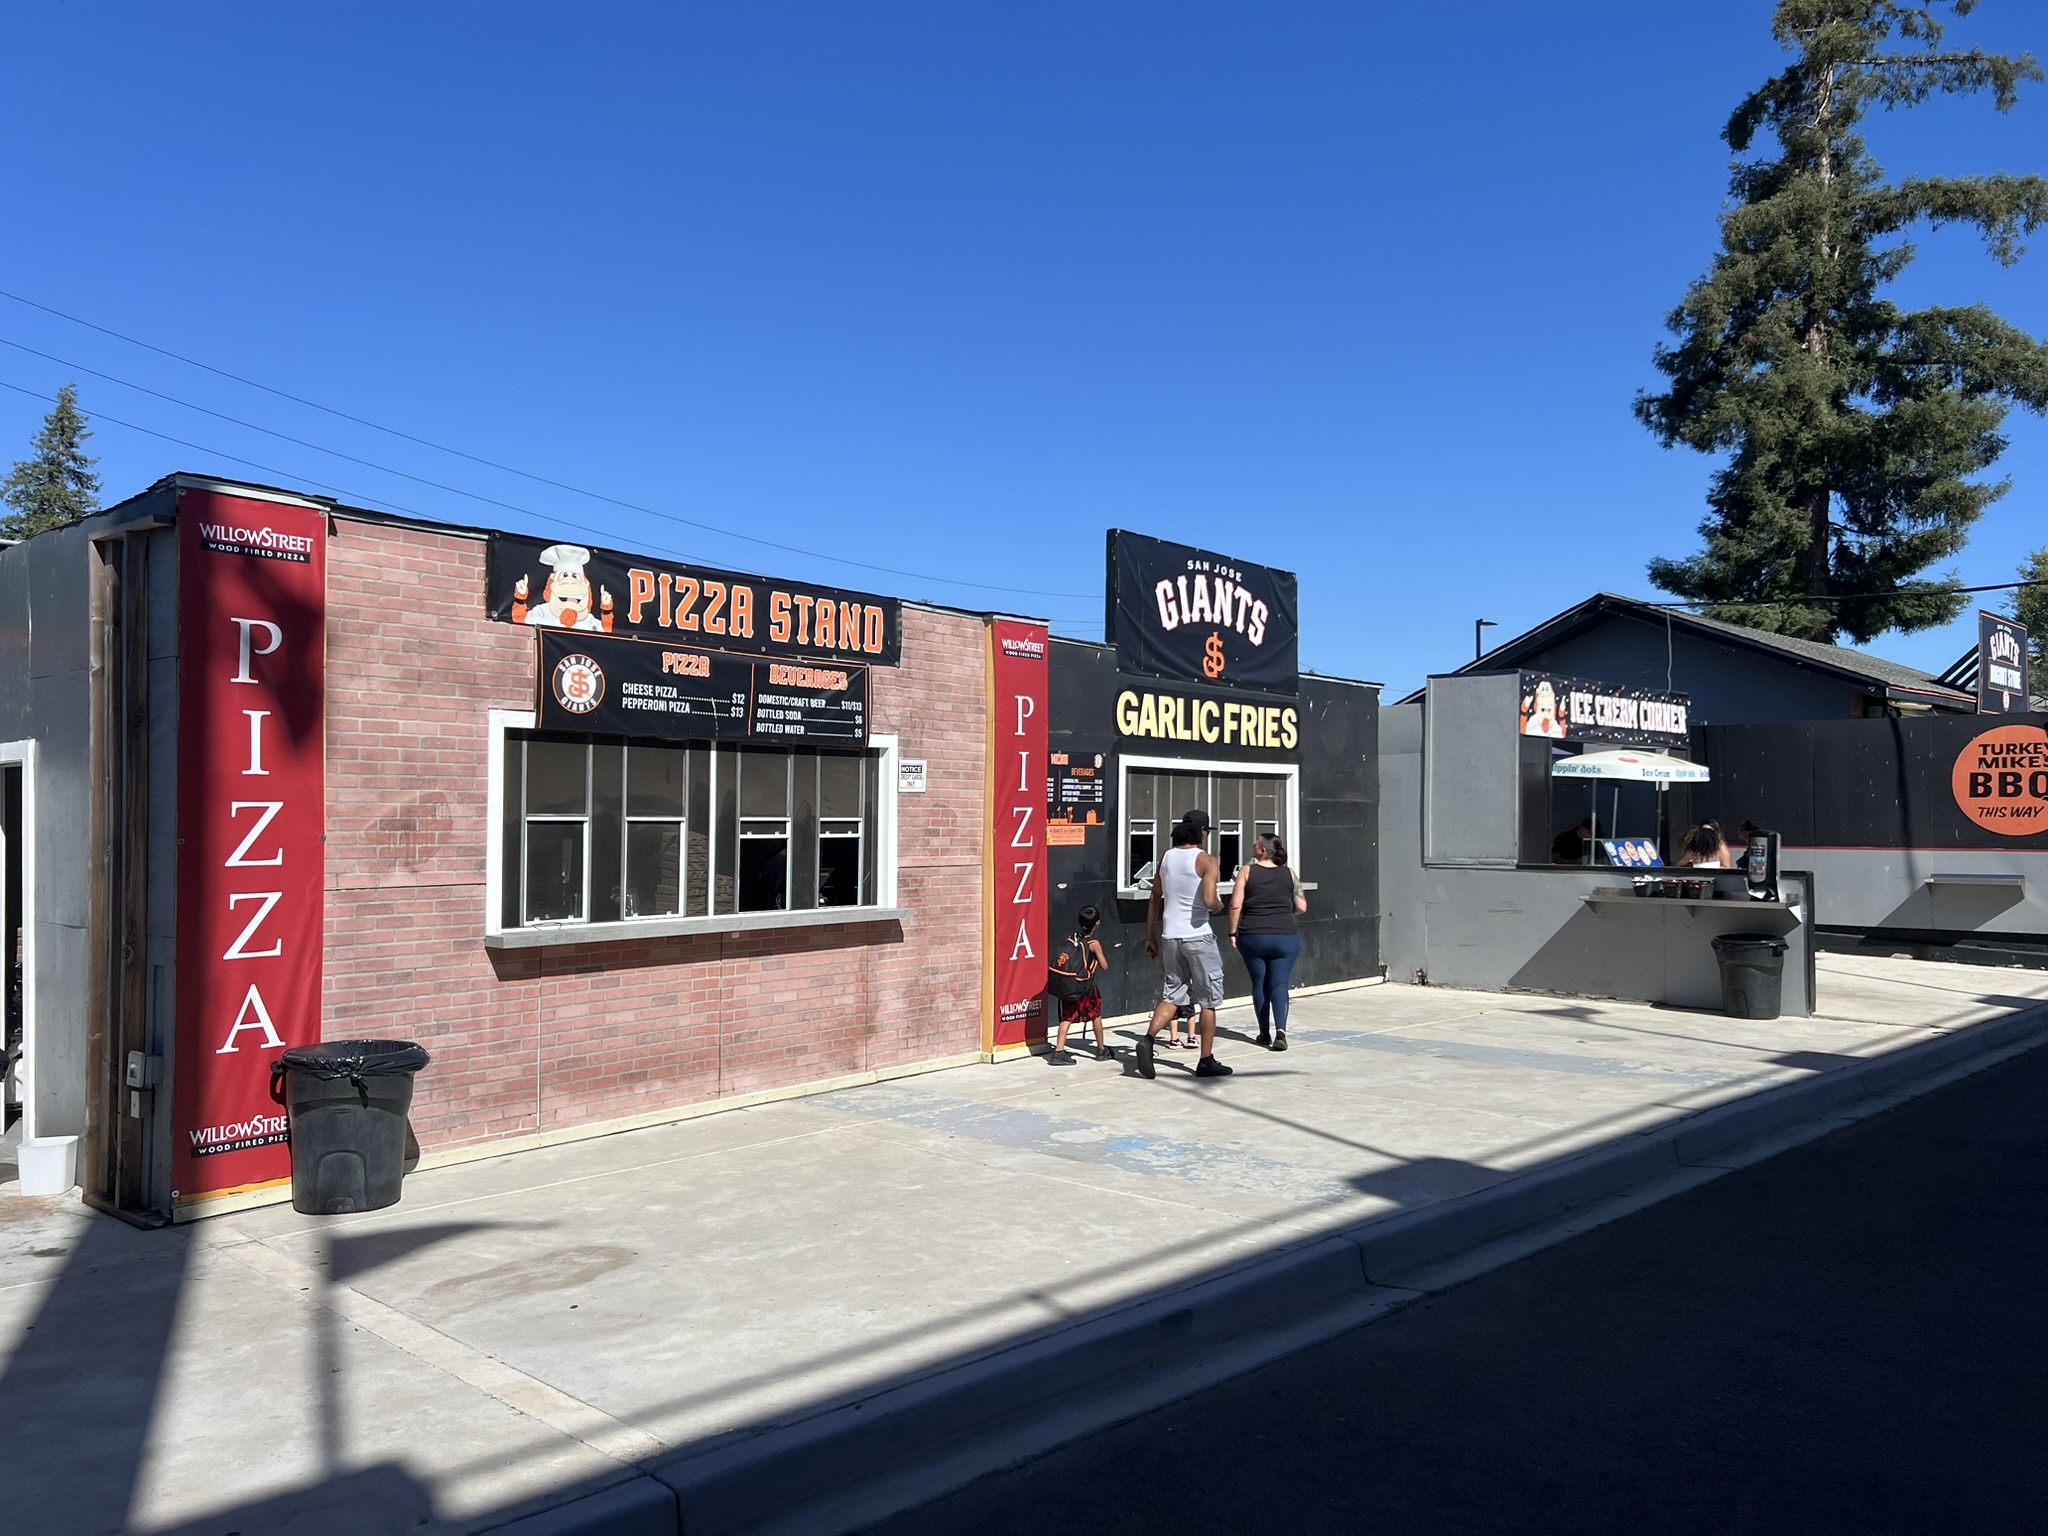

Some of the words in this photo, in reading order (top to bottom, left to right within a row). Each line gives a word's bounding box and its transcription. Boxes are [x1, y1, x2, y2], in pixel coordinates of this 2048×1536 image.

[199, 523, 313, 552] WILLOWSTREET
[209, 543, 239, 553] WOOD
[245, 548, 273, 558] FIRED
[277, 552, 305, 561] PIZZA
[1187, 560, 1210, 571] SAN
[1213, 564, 1242, 582] JOSE
[627, 567, 754, 638] PIZZA
[769, 590, 884, 654] STAND
[1155, 574, 1268, 647] GIANTS
[1001, 638, 1044, 653] WILLOWSTREET
[1989, 630, 2019, 667] GIANTS
[559, 657, 577, 672] SAN
[581, 657, 601, 678] JOSE
[662, 652, 710, 677] PIZZA
[769, 664, 848, 691] BEVERAGES
[560, 696, 597, 712] GIANTS
[622, 682, 653, 697] CHEESE
[655, 685, 677, 698] PIZZA
[732, 692, 745, 704] $12
[758, 694, 809, 708] DOMESTIC/CRAFT
[810, 699, 826, 708] BEER
[622, 697, 667, 711] PEPPERONI
[669, 701, 690, 713] PIZZA
[731, 706, 744, 718] $13
[757, 708, 784, 719] BOTTLED
[785, 710, 801, 720] SODA
[855, 715, 862, 724] $6
[1570, 692, 1595, 724] ICE
[1595, 695, 1638, 729] CREAM
[1640, 701, 1687, 734] CORNER
[756, 723, 783, 733] BOTTLED
[785, 724, 805, 735] WATER
[854, 729, 862, 738] $5
[1116, 690, 1220, 743] GARLIC
[1223, 702, 1298, 749] FRIES
[1642, 768, 1653, 777] Ice
[1969, 771, 2048, 801] BBQ
[1978, 806, 2007, 818] THIS
[2010, 806, 2044, 818] WAY
[216, 617, 286, 1054] PIZZA
[1009, 695, 1035, 960] PIZZA
[189, 1114, 288, 1145] WILLOWSTRE
[199, 1143, 231, 1154] WOOD
[235, 1138, 264, 1149] FIRED
[268, 1134, 289, 1143] PIZZ
